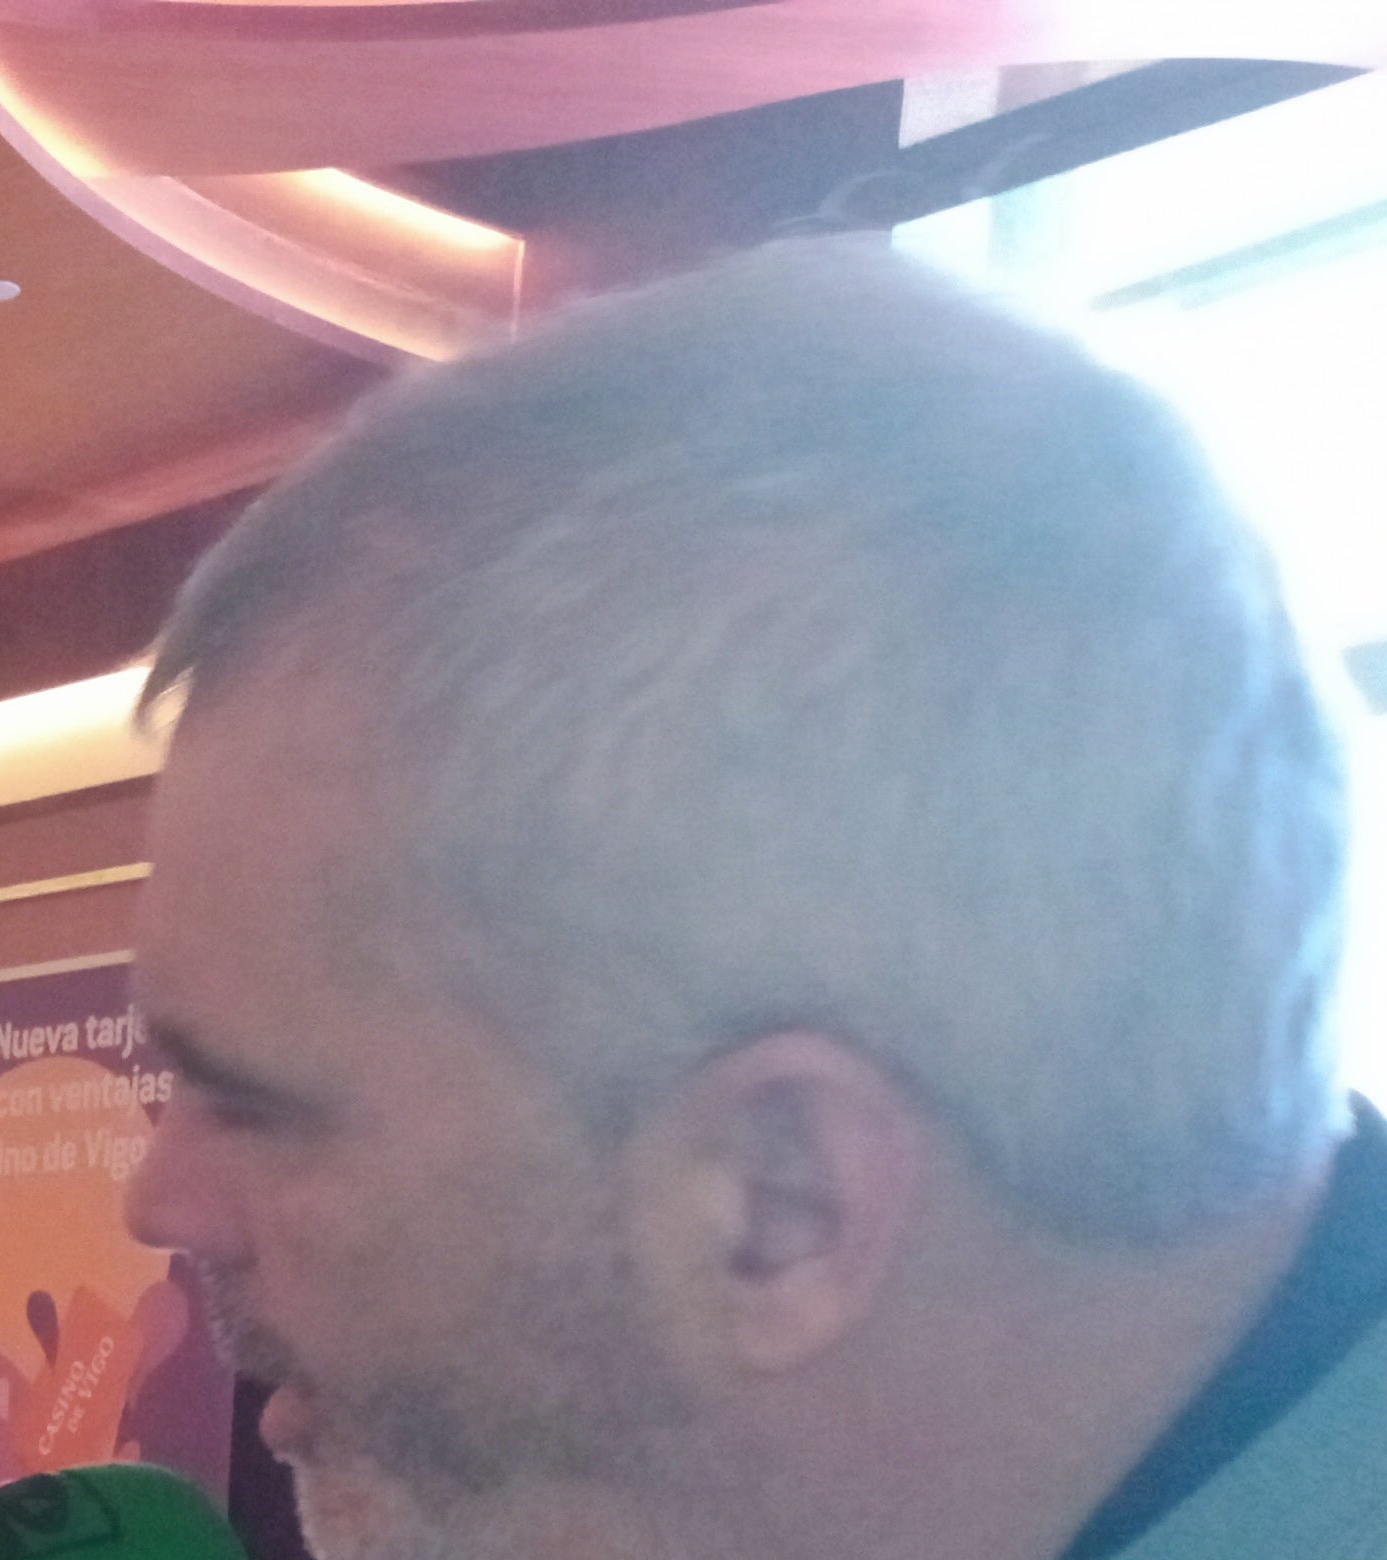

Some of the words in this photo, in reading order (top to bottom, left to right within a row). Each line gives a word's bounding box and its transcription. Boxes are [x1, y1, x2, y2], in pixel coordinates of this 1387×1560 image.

[47, 1064, 175, 1114] ventajas
[42, 1132, 77, 1172] de
[83, 1127, 148, 1182] Vigo
[77, 1335, 115, 1399] VIGO
[38, 1360, 85, 1456] CASINO
